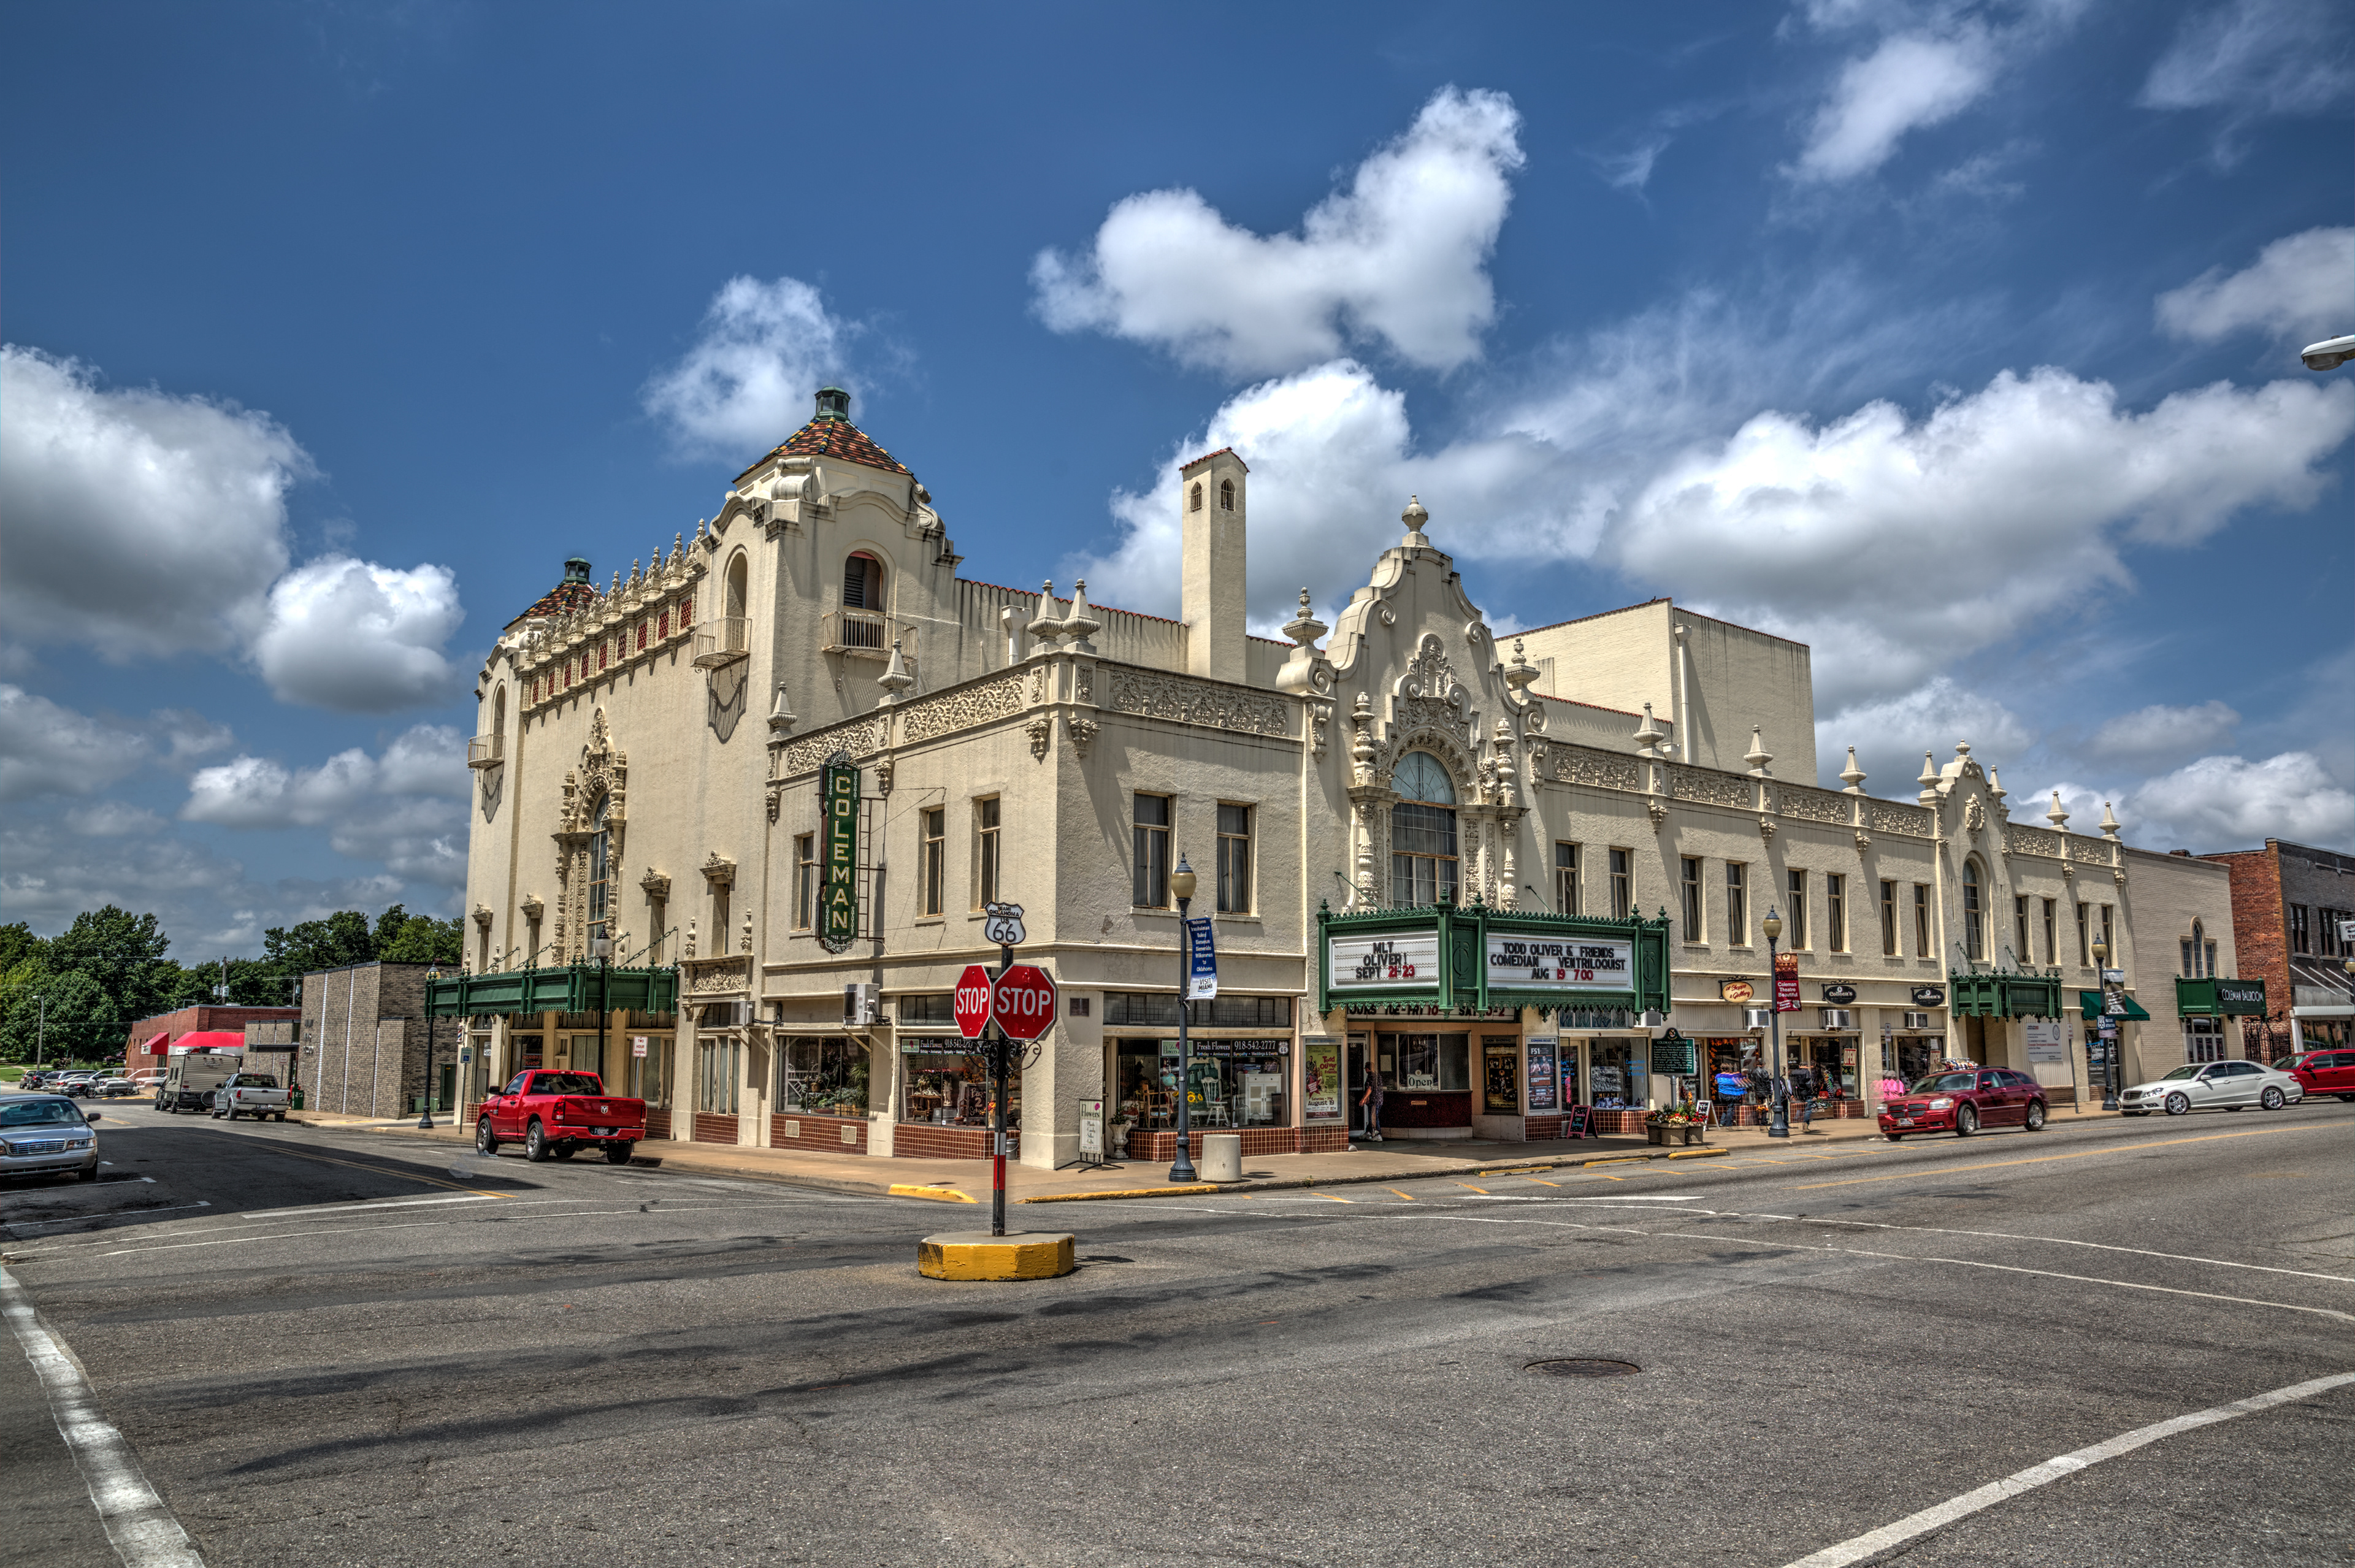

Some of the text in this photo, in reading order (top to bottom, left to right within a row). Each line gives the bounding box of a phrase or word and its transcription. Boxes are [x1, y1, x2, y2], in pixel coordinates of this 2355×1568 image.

[832, 776, 851, 929] COLEMAN
[993, 922, 1016, 942] 66
[1373, 941, 1393, 954] MLT
[1503, 943, 1614, 958] TODD OLIVER & FRIENDS
[1490, 954, 1626, 970] COMEDIAN VENTRILOQUIST
[1356, 966, 1380, 979] SEPT
[1531, 968, 1550, 979] AUG
[1557, 968, 1566, 980] 19
[957, 987, 989, 1014] STOP
[997, 987, 1051, 1015] STOP
[2222, 989, 2264, 1001] COLEMAN BALLROOM
[921, 1039, 942, 1047] Fresh Flowers
[1197, 1041, 1230, 1050] Fresh Flowers
[1235, 1041, 1276, 1050] 918-542-2777
[1845, 1050, 1856, 1065] OPEN
[1409, 1077, 1432, 1089] Open
[975, 1097, 982, 1107] 2
[1081, 1104, 1100, 1117] Flowers
